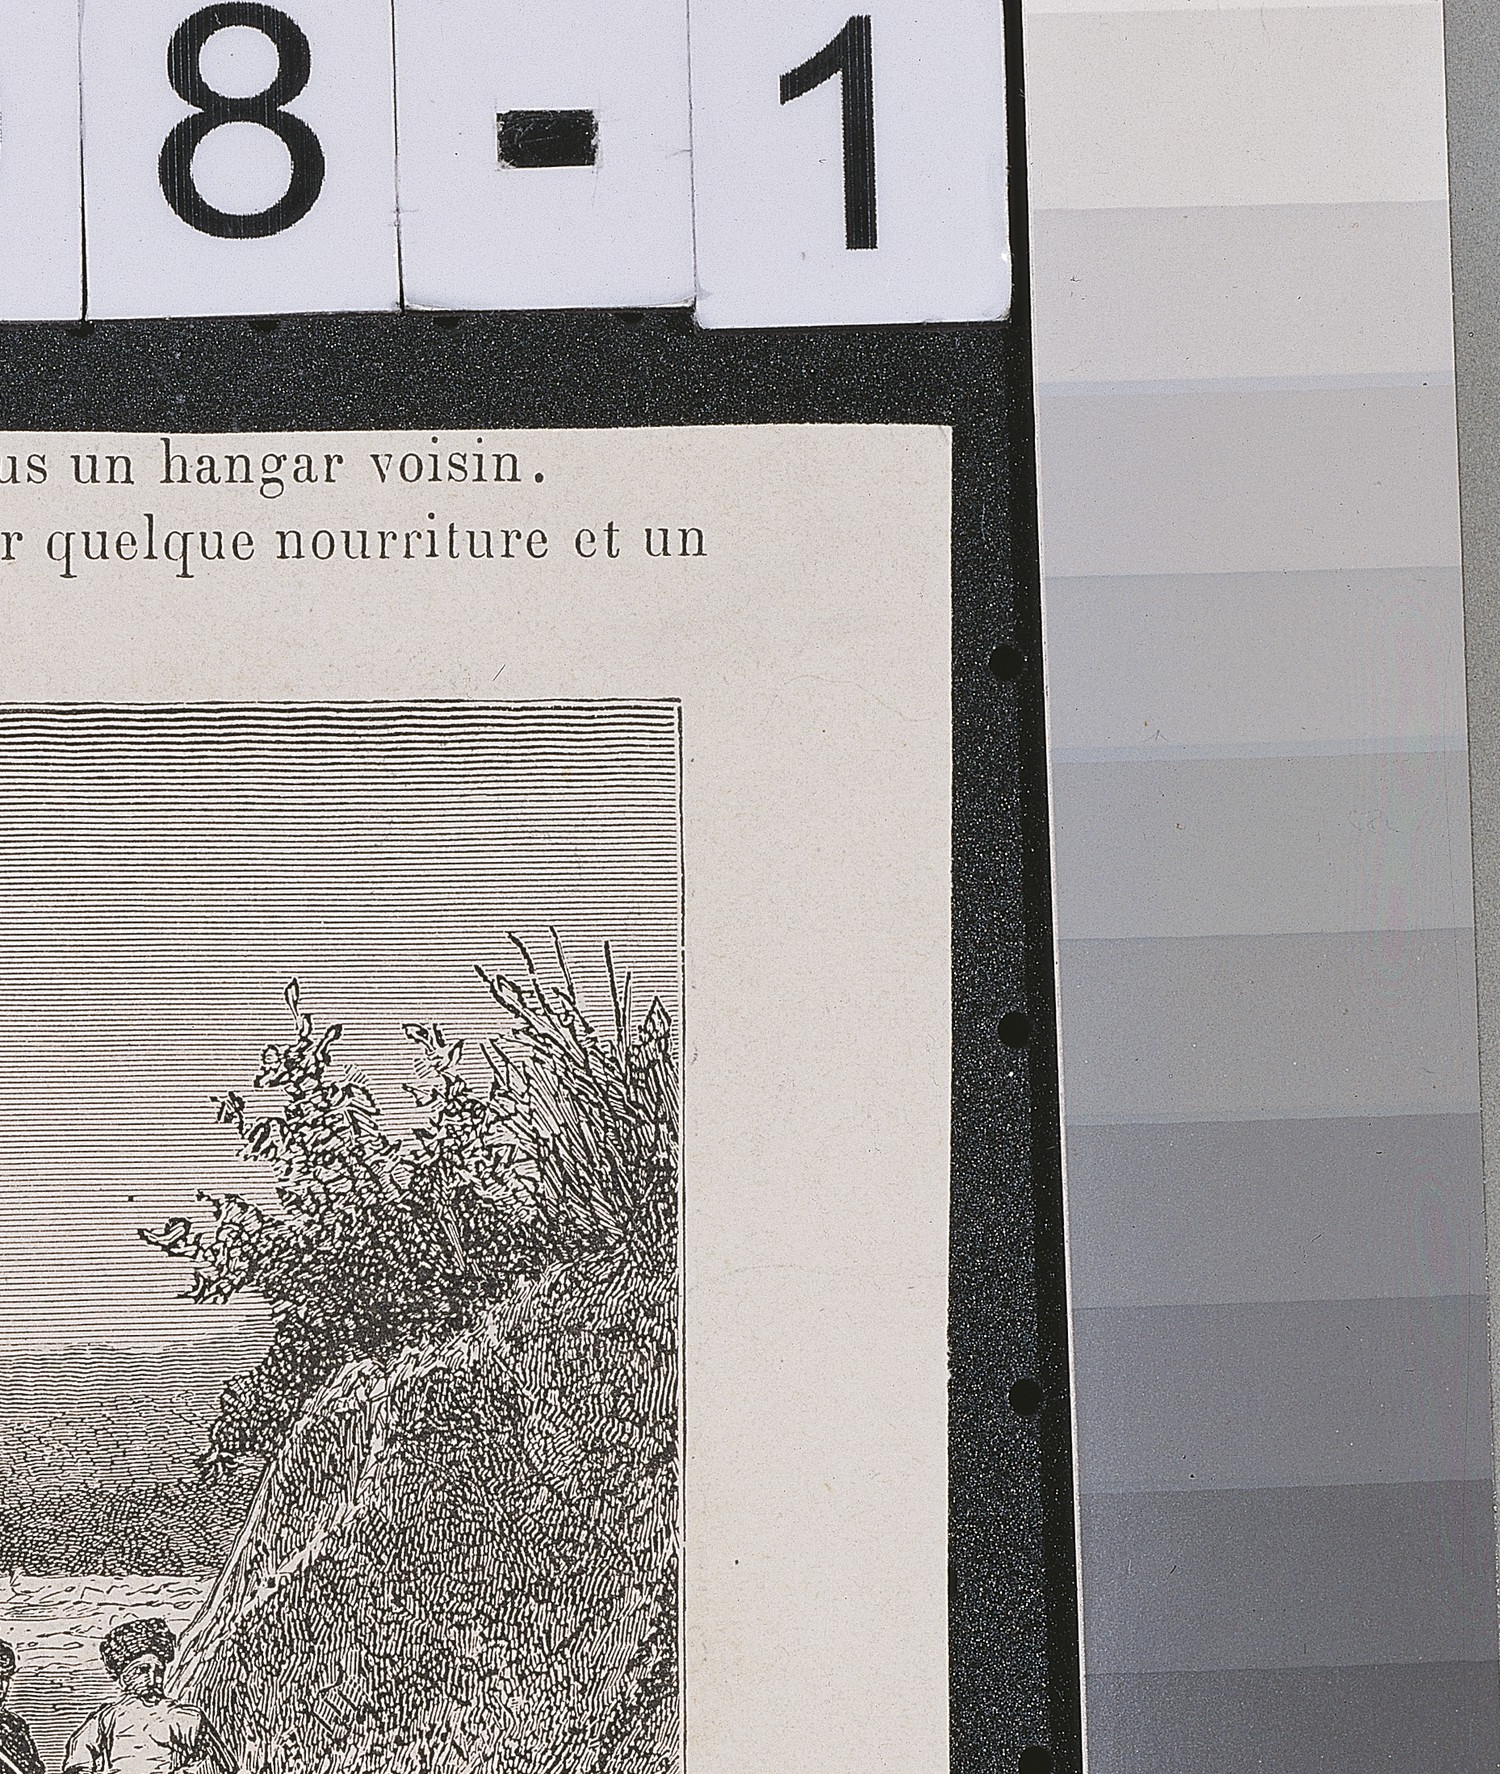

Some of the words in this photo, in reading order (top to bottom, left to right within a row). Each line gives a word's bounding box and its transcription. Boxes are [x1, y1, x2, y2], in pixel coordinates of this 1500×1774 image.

[70, 454, 135, 485] un
[159, 437, 344, 500] hangar
[369, 436, 544, 484] voisin.
[46, 513, 255, 579] quelque
[275, 512, 549, 560] nourriture
[575, 520, 620, 559] et
[644, 527, 708, 557] un
